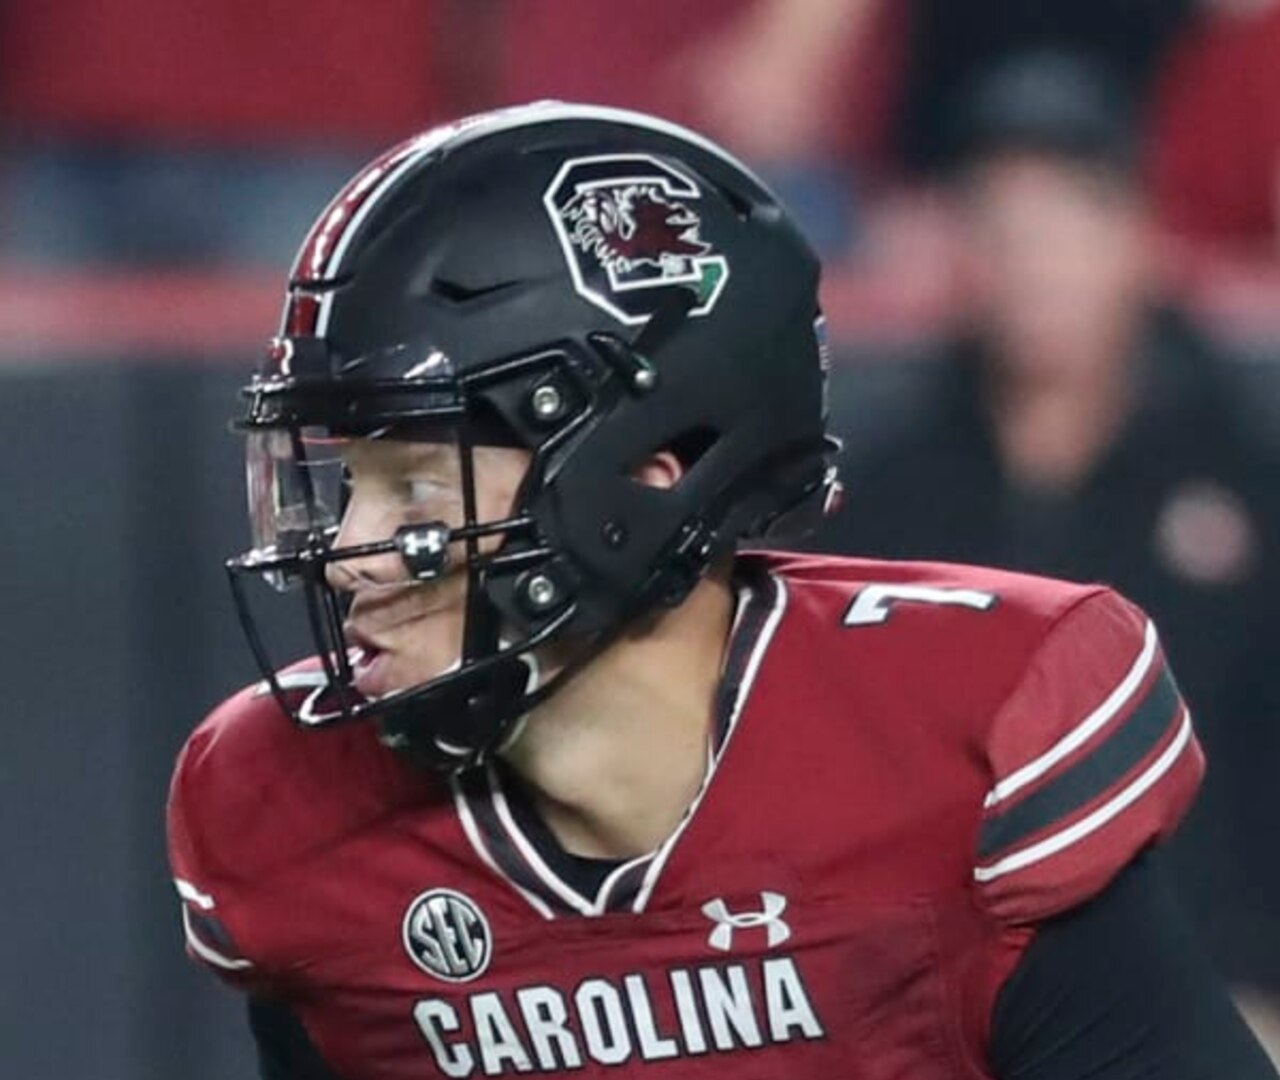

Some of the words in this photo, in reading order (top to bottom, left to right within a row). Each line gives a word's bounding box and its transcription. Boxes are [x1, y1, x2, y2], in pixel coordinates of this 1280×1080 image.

[841, 583, 999, 626] 7
[410, 896, 484, 975] SEC
[412, 955, 825, 1080] CAROLINA
